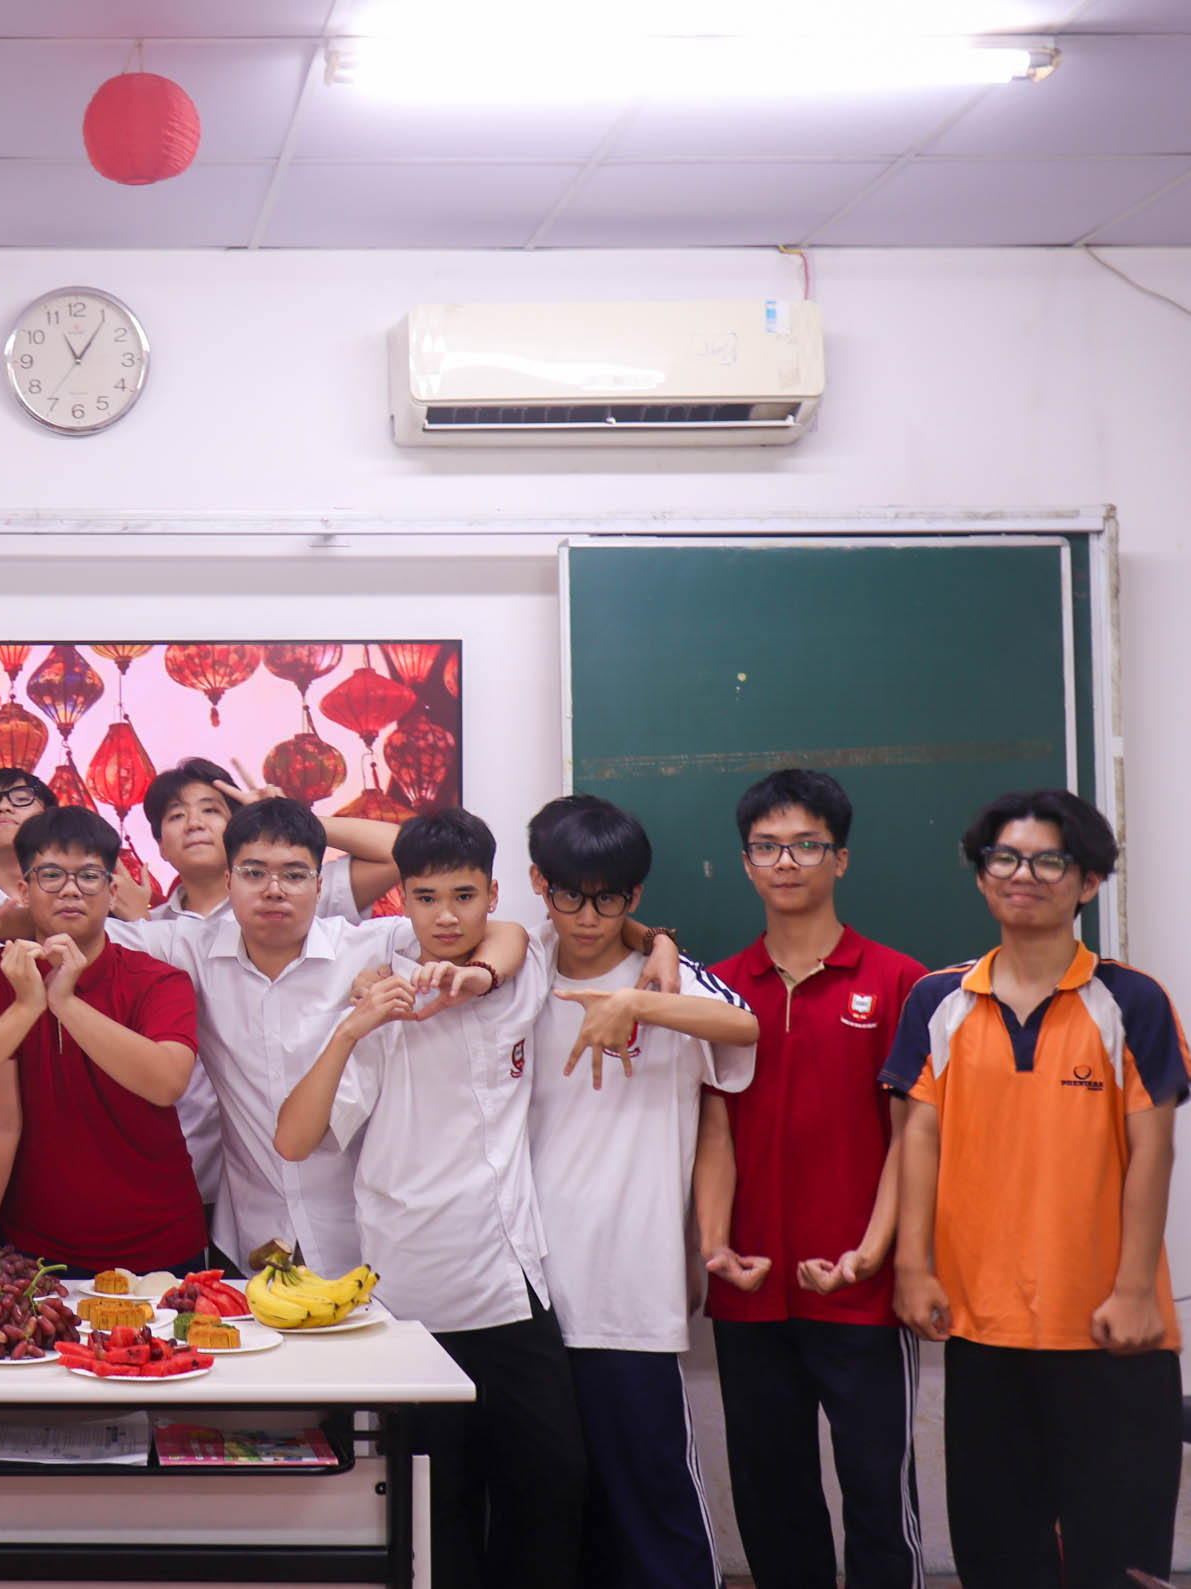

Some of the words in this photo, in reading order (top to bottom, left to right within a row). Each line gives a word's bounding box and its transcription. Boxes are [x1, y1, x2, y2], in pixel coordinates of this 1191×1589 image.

[68, 302, 86, 317] 12
[100, 309, 105, 322] 1
[46, 311, 59, 325] 11
[28, 329, 45, 344] 10
[113, 327, 128, 342] 2
[20, 354, 33, 369] 9
[121, 352, 135, 368] 3
[28, 379, 42, 394] 8
[113, 378, 128, 392] 4
[47, 397, 60, 412] 7
[96, 396, 109, 411] 5
[71, 404, 85, 419] 6
